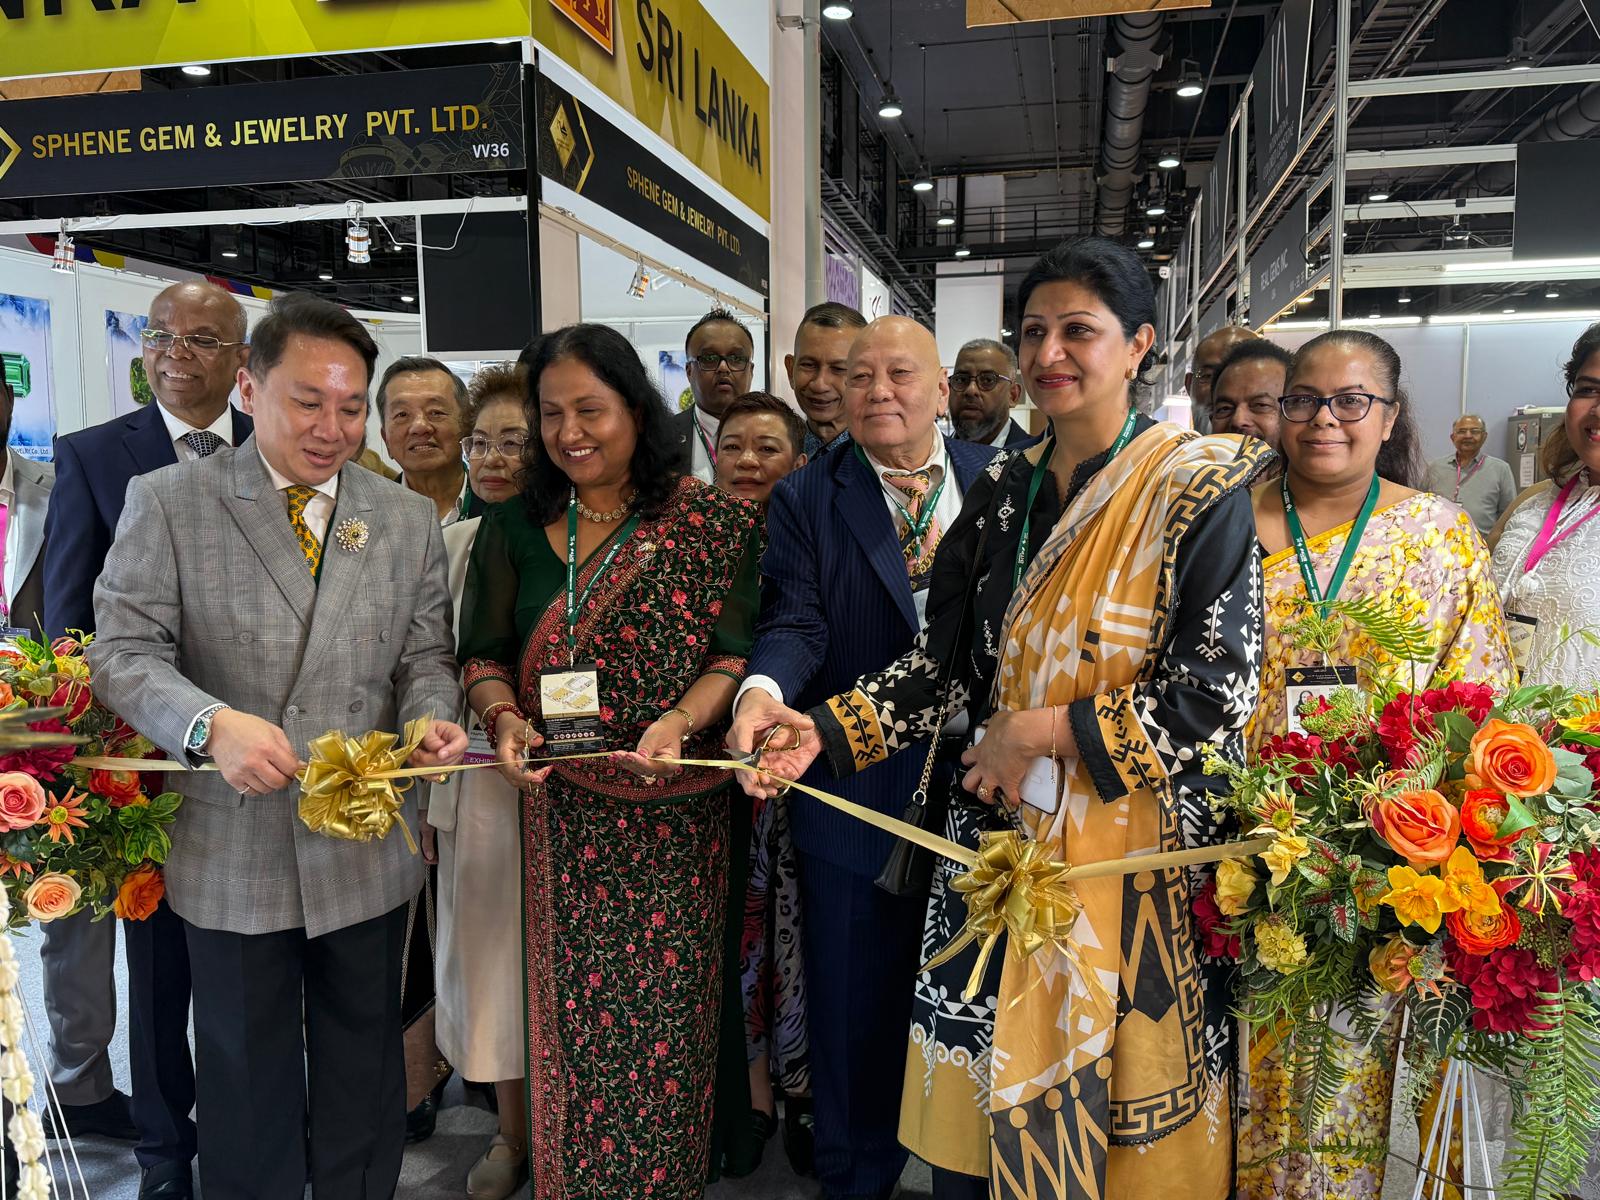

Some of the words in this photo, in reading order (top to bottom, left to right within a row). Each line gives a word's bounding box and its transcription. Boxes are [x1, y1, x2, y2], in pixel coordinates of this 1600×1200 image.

[32, 129, 132, 159] SPHENE
[139, 124, 195, 151] GEM
[204, 122, 223, 148] &
[230, 113, 348, 146] JEWELRY
[366, 108, 421, 137] PVT.
[431, 104, 488, 133] LTD.
[636, 0, 683, 102] SRI
[694, 47, 762, 176] LANKA
[626, 165, 661, 206] SPHENE
[661, 189, 679, 217] GEM
[680, 201, 686, 221] &
[687, 205, 715, 239] JEWELRY
[717, 225, 729, 249] PVT.
[730, 234, 742, 257] LTD.
